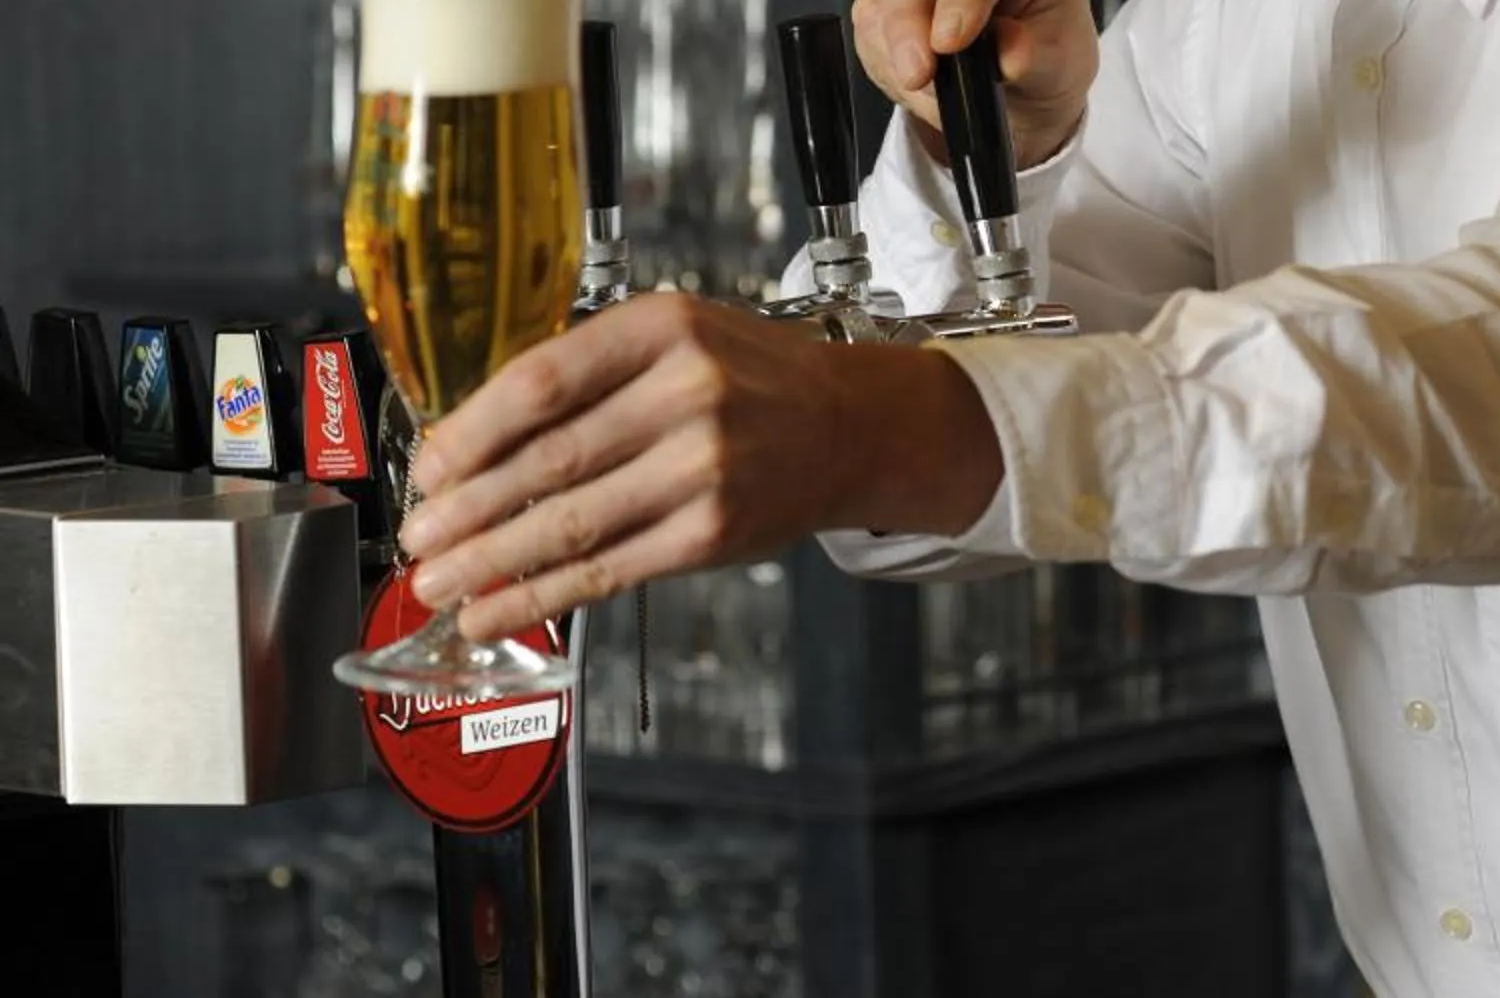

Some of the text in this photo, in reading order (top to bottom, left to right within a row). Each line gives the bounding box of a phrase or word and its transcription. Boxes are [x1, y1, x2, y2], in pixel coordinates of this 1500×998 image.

[124, 335, 162, 423] Sprite
[216, 386, 261, 420] Fanta
[470, 715, 547, 744] Weizen
